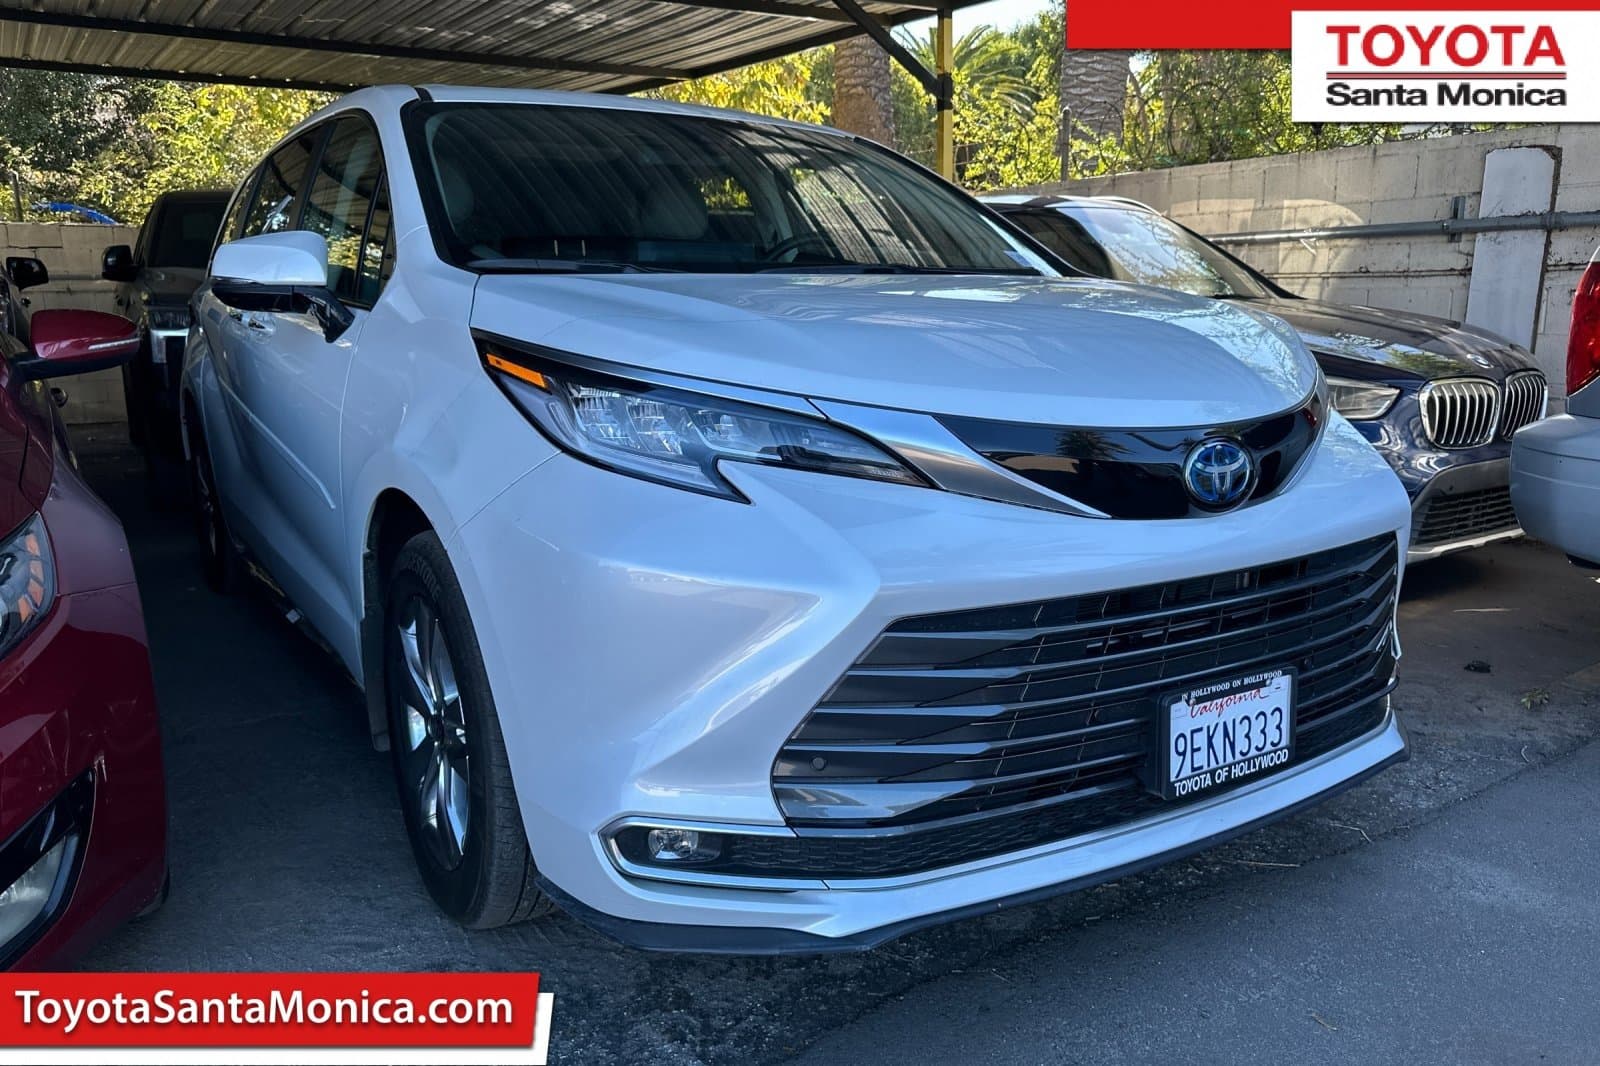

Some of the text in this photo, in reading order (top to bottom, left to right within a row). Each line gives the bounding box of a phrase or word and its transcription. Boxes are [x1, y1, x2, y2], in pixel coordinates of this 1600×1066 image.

[1190, 682, 1230, 699] HOLLYWOOD
[1232, 679, 1242, 688] ON
[1243, 670, 1282, 684] HOLLYWOOD
[1174, 706, 1283, 779] 9EKN333
[1174, 749, 1289, 796] TOYOTA OF HOLLYWOOD
